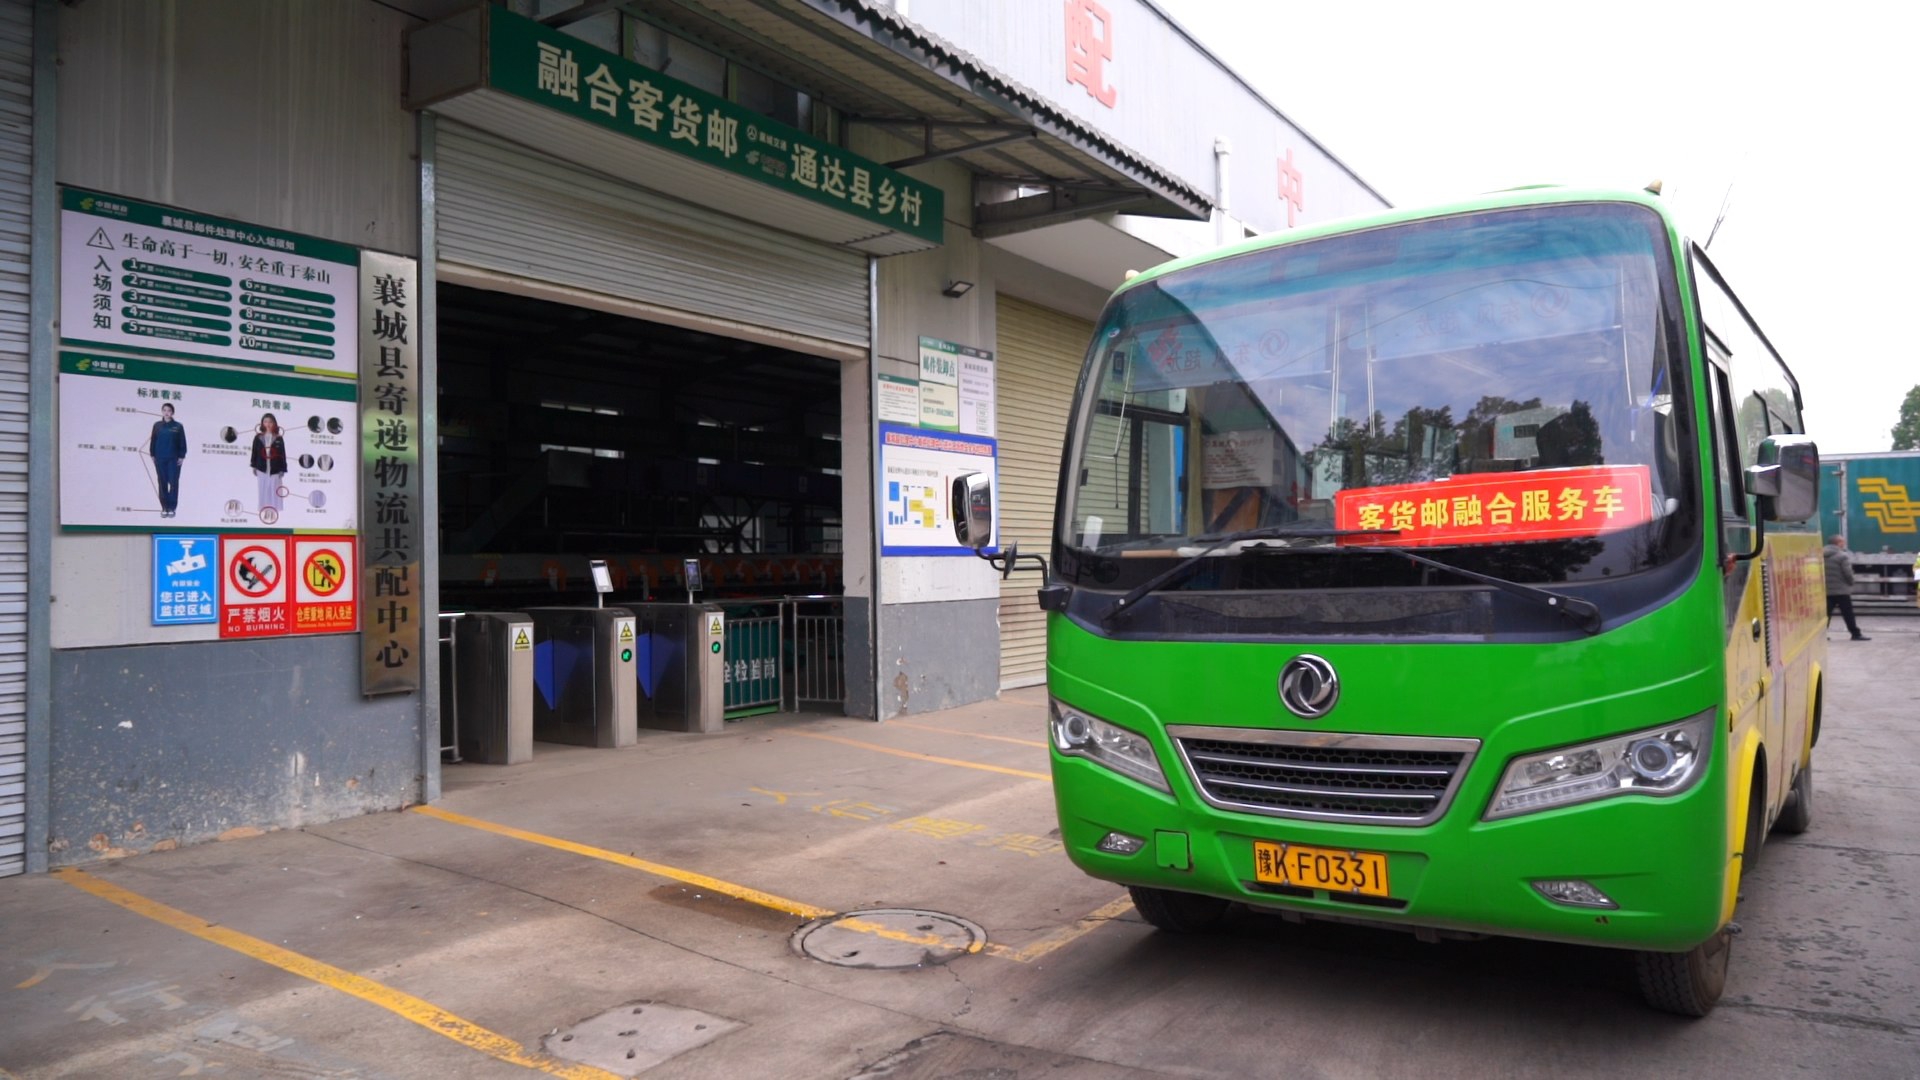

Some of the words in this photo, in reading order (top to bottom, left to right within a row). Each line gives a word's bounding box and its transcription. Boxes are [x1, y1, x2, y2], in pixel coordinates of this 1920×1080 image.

[536, 40, 740, 159] 融合客货邮
[1063, 0, 1117, 109] 配
[1277, 147, 1303, 228] 中
[790, 143, 923, 227] 通达县乡村
[130, 258, 138, 269] 1
[130, 275, 138, 285] 2
[245, 280, 253, 289] 6
[92, 254, 113, 331] 入场须知
[129, 290, 138, 301] 3
[245, 294, 253, 303] 7
[129, 306, 138, 316] 4
[245, 309, 253, 318] 8
[129, 321, 138, 332] 5
[246, 323, 254, 333] 9
[241, 336, 255, 348] 10
[136, 387, 183, 401] 标准着装
[251, 398, 292, 411] 风险着装
[372, 273, 409, 670] 襄城县寄递物流共配中心
[1357, 485, 1625, 532] 客货邮融合服务车
[160, 591, 212, 603] 您已进入
[160, 603, 212, 617] 监控区域
[227, 606, 285, 625] 严禁烟火
[227, 625, 240, 633] NO
[246, 623, 285, 632] BURNING
